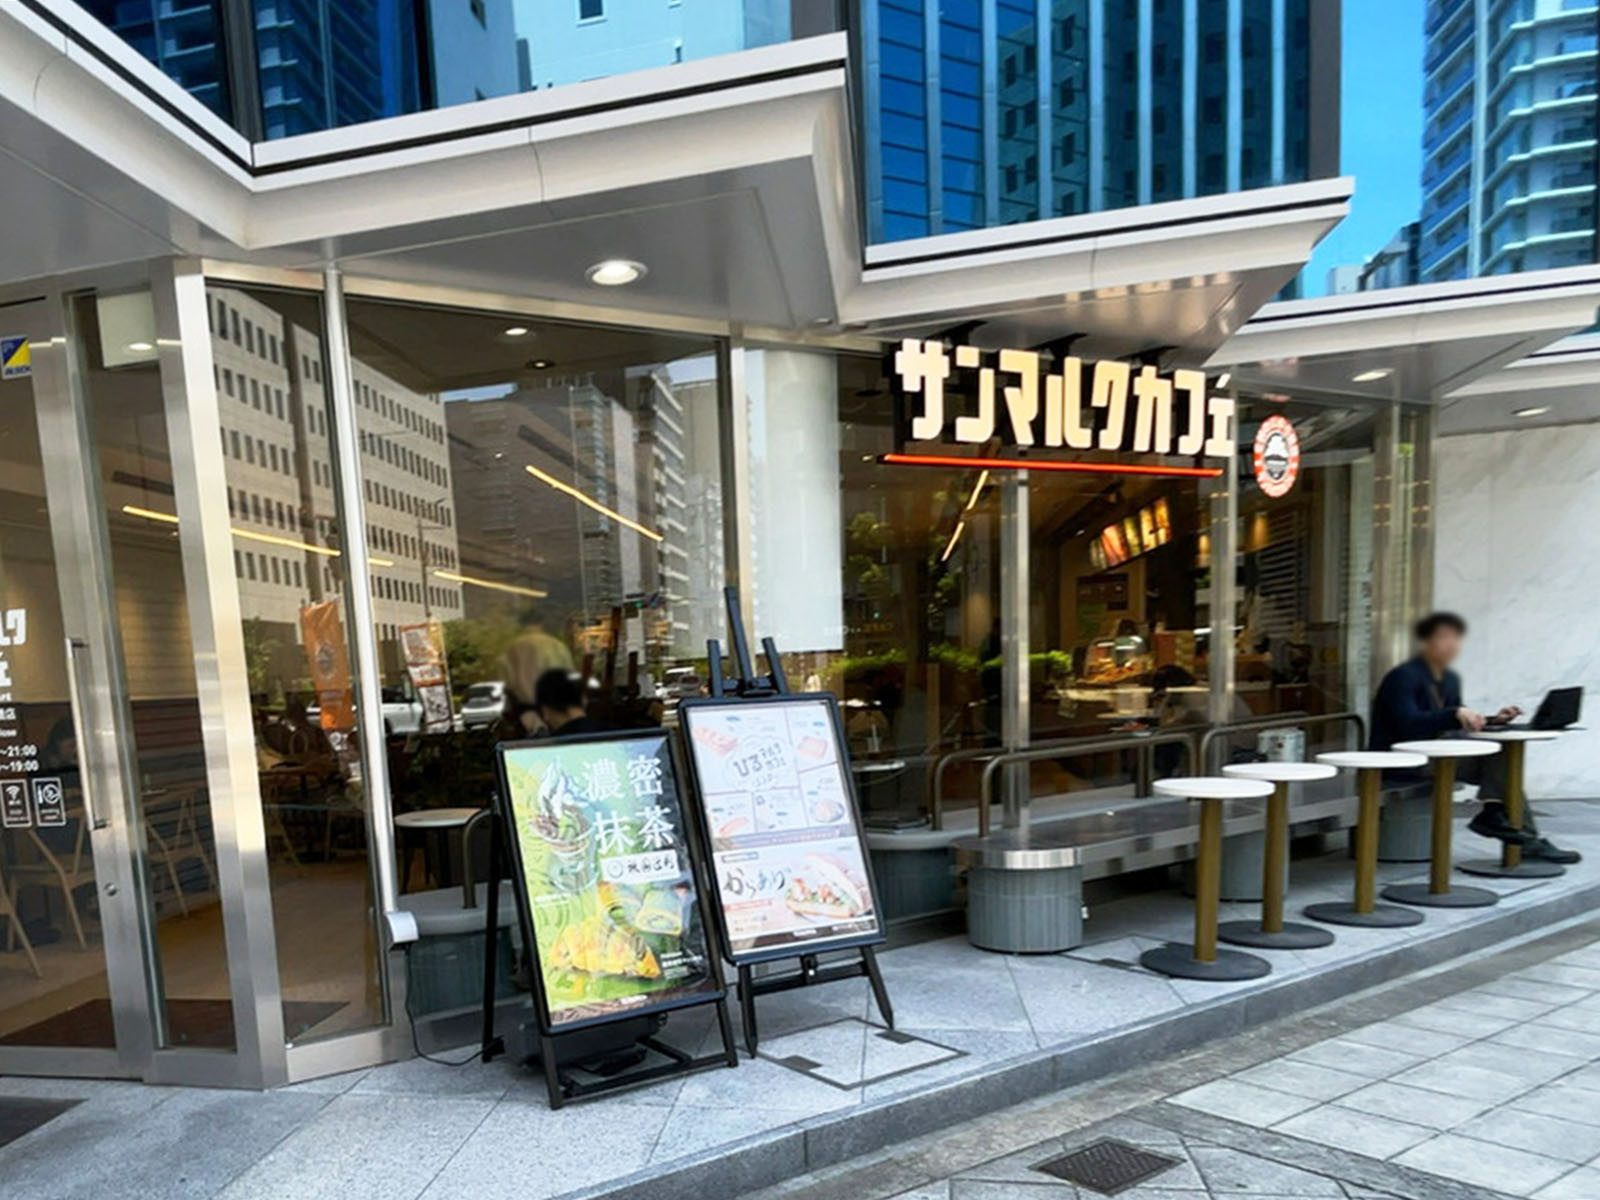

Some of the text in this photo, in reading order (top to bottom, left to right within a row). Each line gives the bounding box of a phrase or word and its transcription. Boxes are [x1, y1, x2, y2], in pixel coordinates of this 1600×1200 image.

[895, 338, 1235, 457] サンマルクカフェ
[581, 755, 664, 801] 濃密
[595, 804, 677, 855] 抹茶
